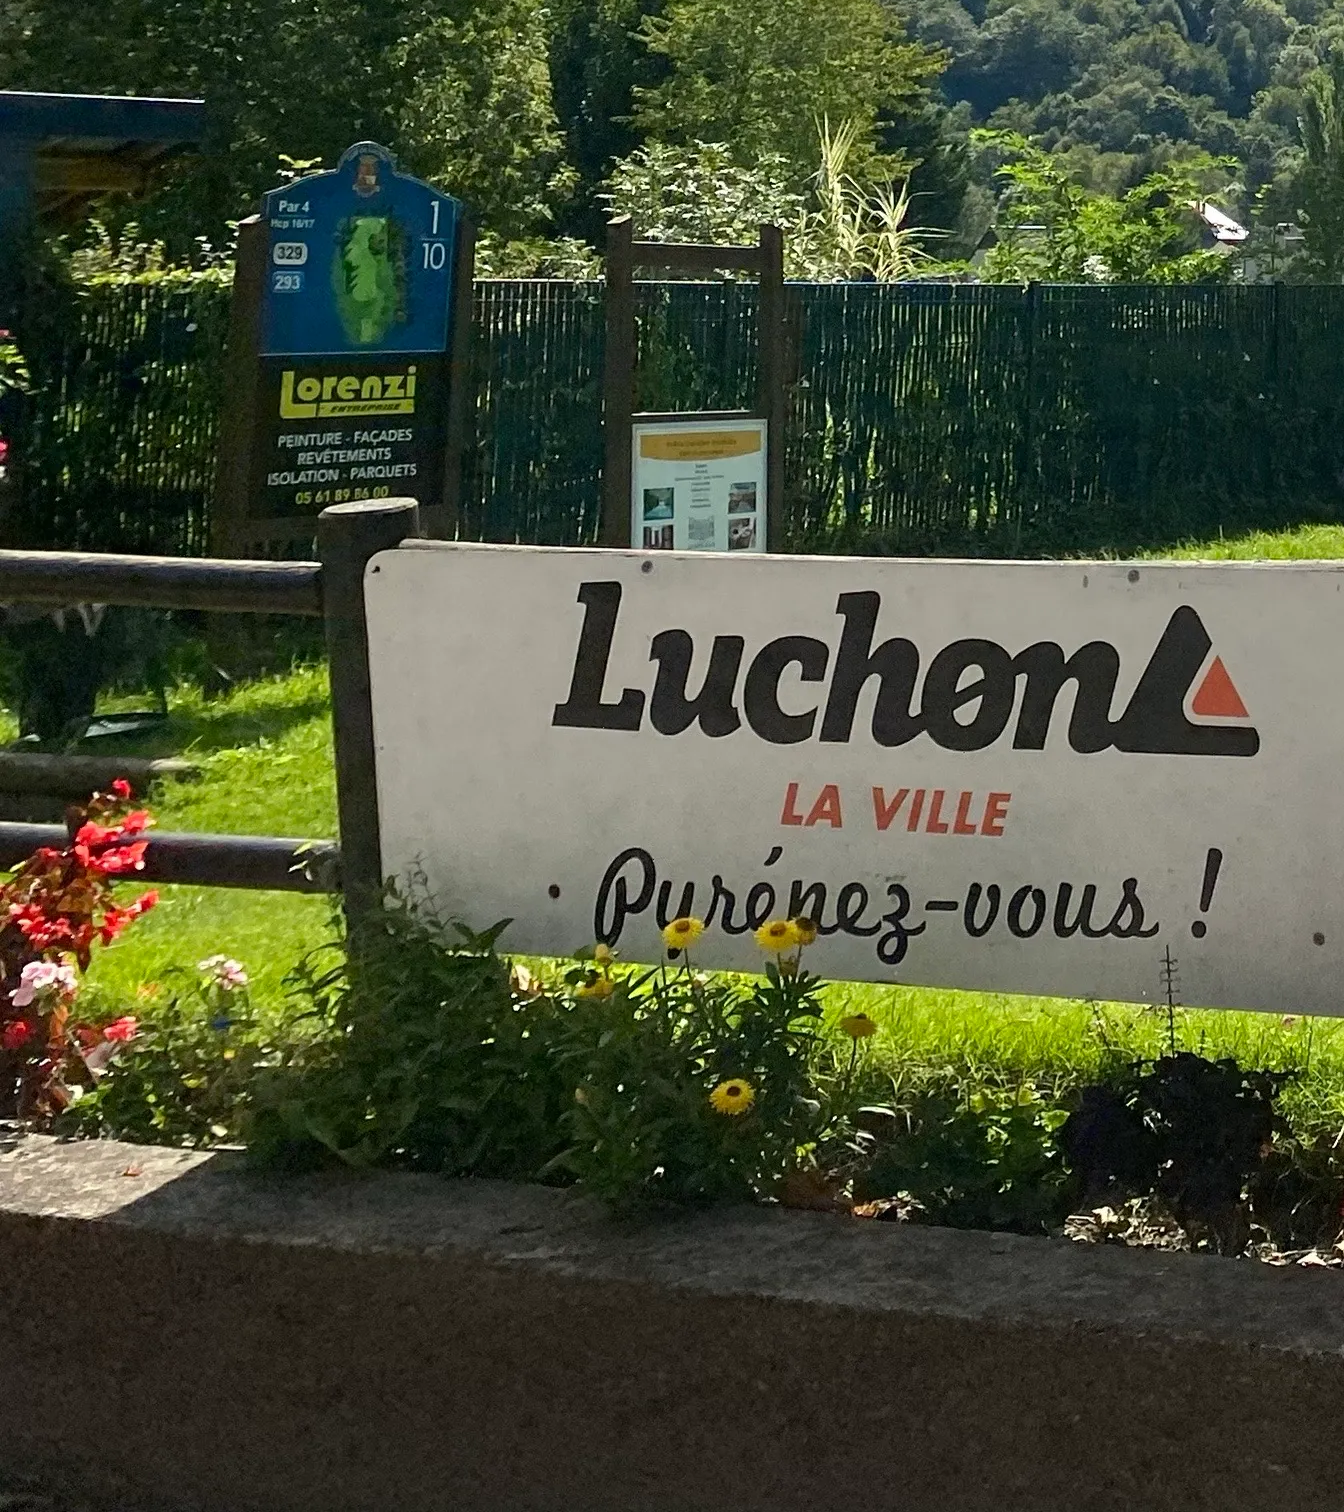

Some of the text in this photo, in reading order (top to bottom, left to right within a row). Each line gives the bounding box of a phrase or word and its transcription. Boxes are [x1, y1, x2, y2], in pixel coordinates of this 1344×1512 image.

[278, 200, 310, 213] Par 4
[431, 200, 440, 234] 1
[277, 246, 303, 260] 329
[423, 243, 446, 270] 10
[275, 275, 300, 290] 293
[280, 366, 417, 419] Lorenzi
[277, 432, 343, 448] PEINTURE
[353, 428, 413, 446] FAÇADES
[267, 469, 340, 486] ISOLATION
[350, 463, 417, 480] PARQUETS
[295, 491, 312, 504] 05
[315, 490, 330, 502] 61
[334, 488, 350, 501] 89
[372, 485, 389, 498] 00
[780, 782, 1012, 837] LA VILLE
[1190, 847, 1224, 939] !
